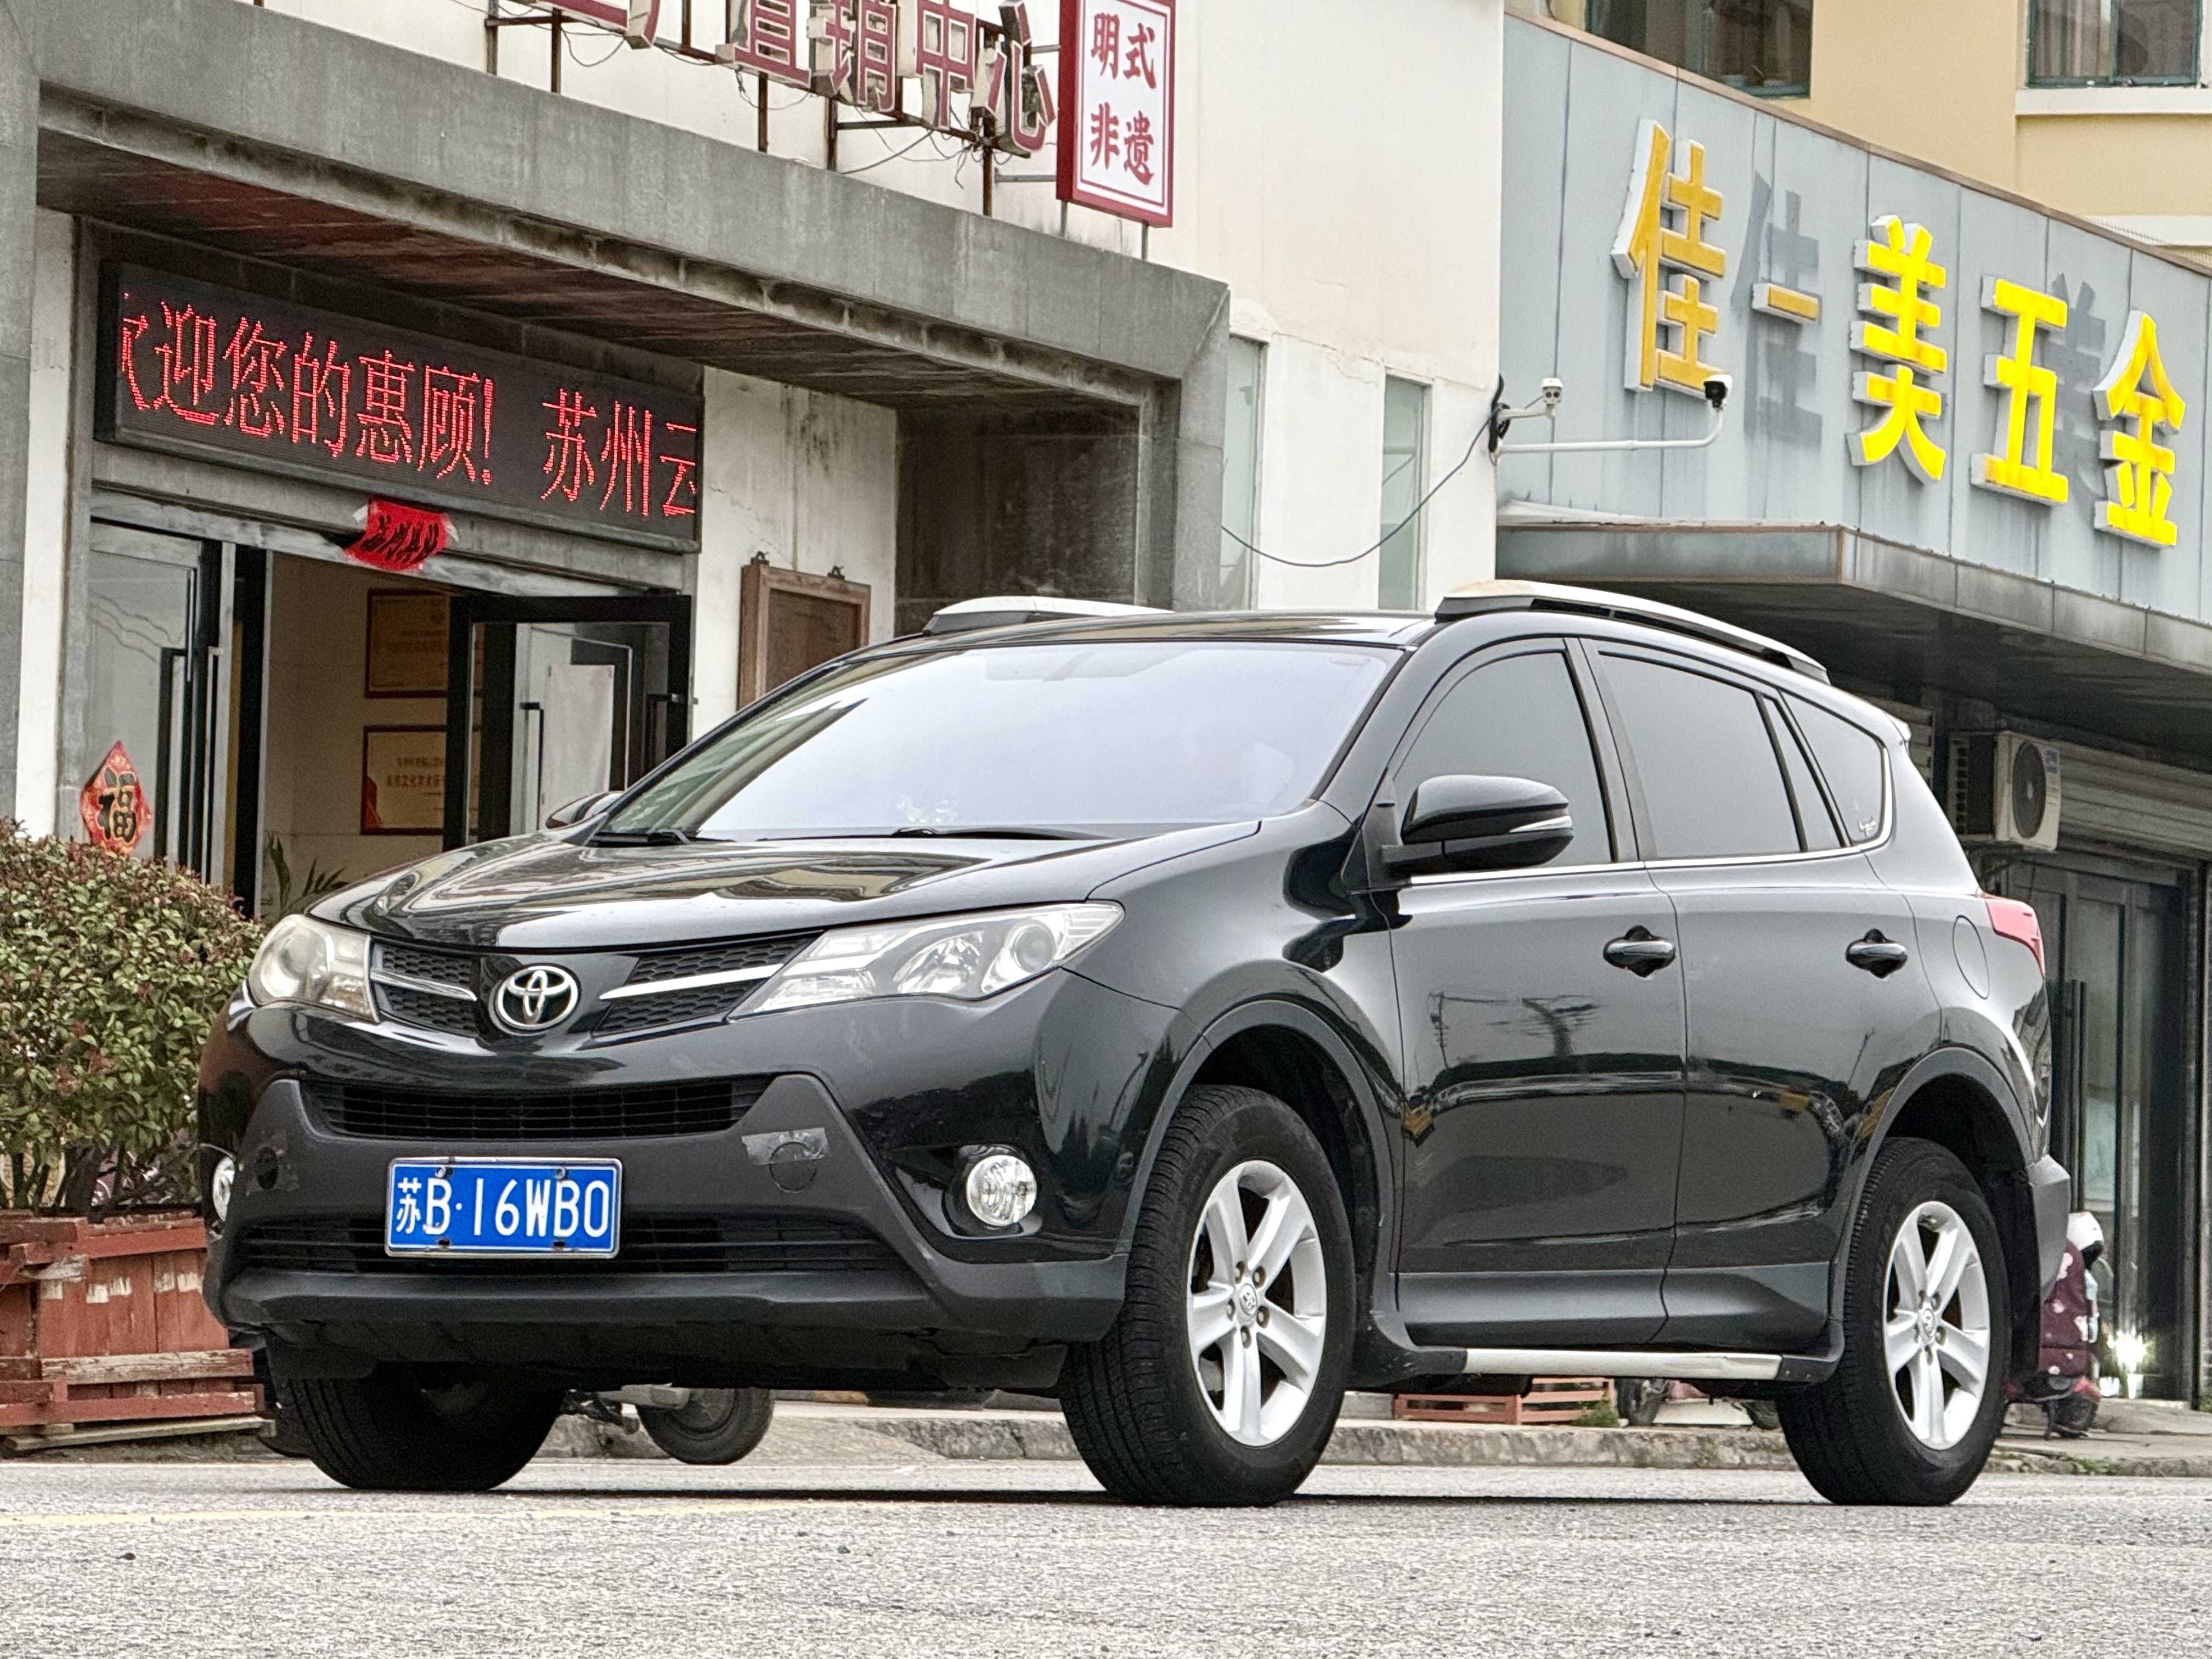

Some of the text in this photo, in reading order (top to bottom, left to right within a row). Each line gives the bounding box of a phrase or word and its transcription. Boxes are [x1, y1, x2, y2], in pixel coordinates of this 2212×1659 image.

[505, 0, 1057, 152] 直销中心
[1091, 12, 1156, 89] 明式
[1091, 101, 1154, 185] 非遗
[97, 766, 137, 843] 福
[396, 1177, 610, 1238] 苏B·16WB0
